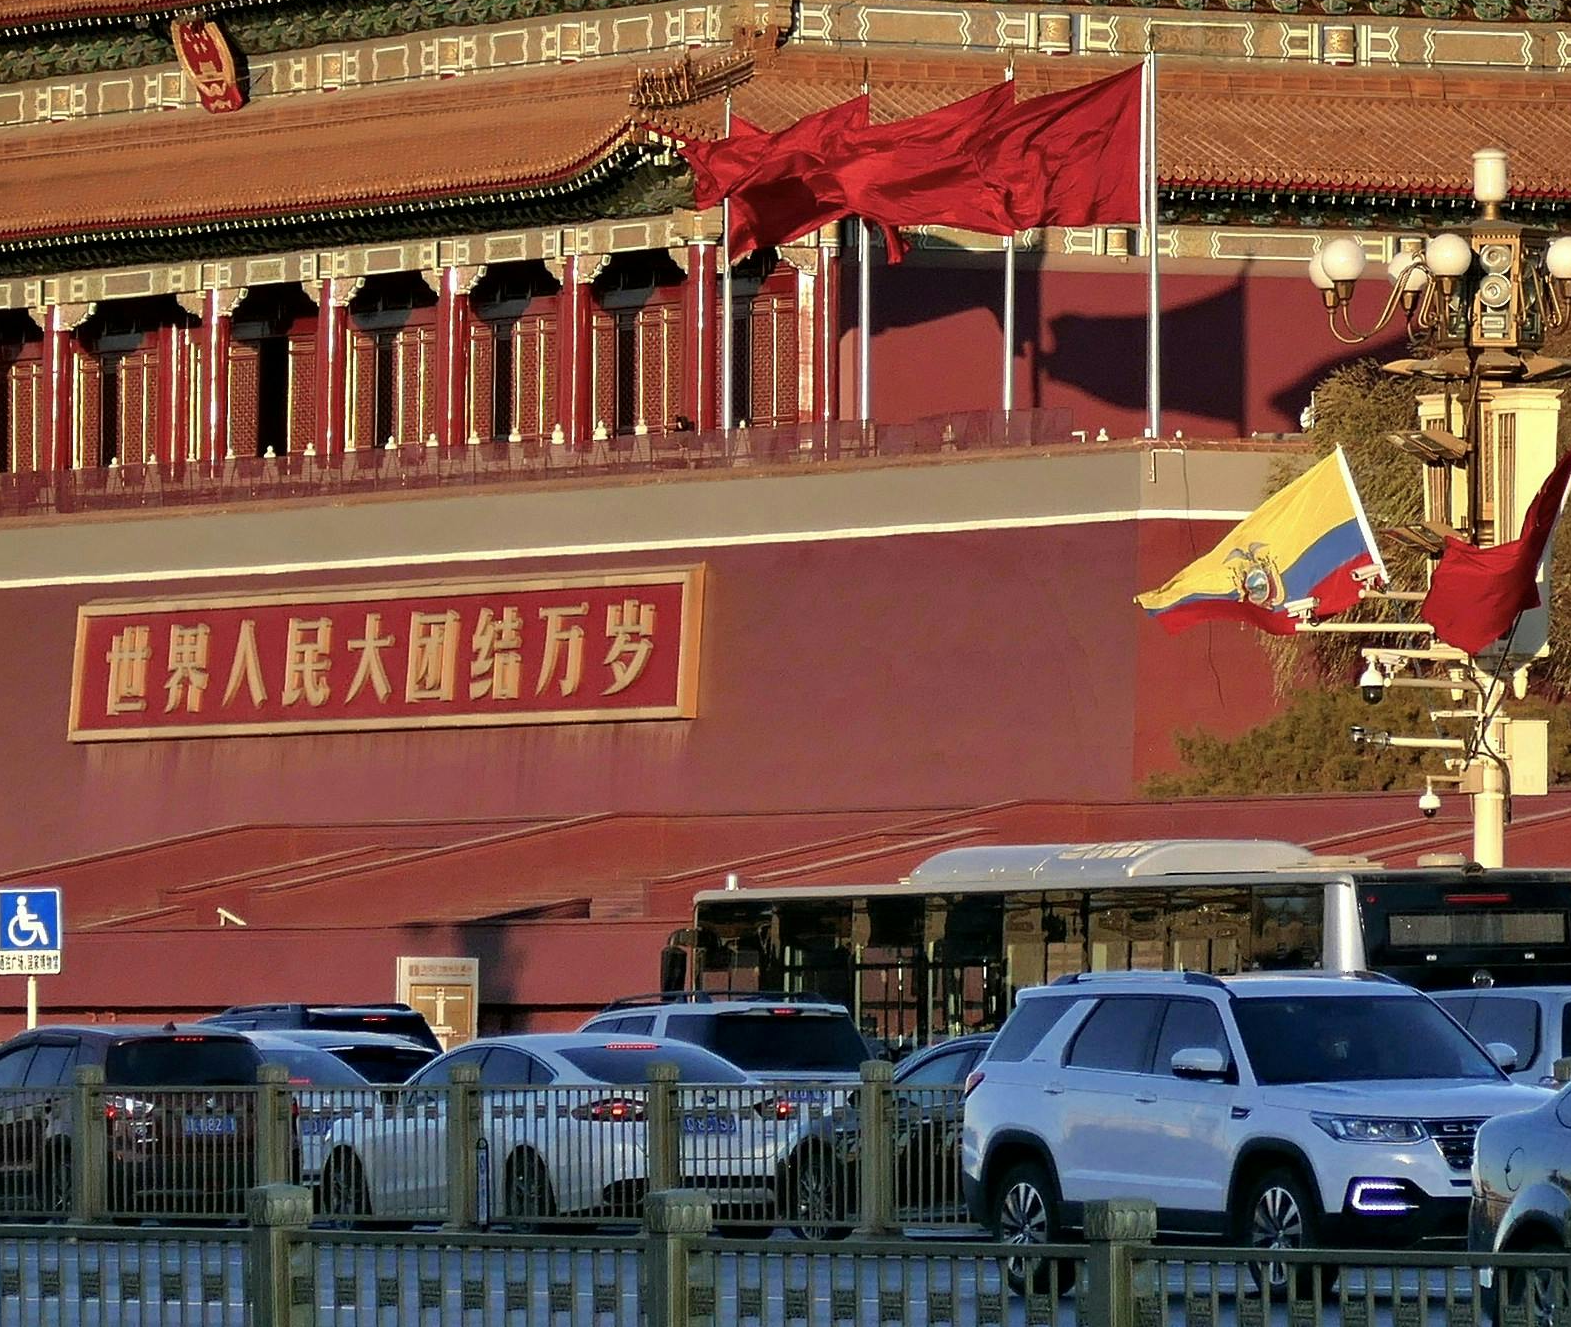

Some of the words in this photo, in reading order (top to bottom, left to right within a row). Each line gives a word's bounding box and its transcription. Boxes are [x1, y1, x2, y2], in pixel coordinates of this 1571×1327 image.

[105, 599, 655, 716] 世界人民大团结万岁
